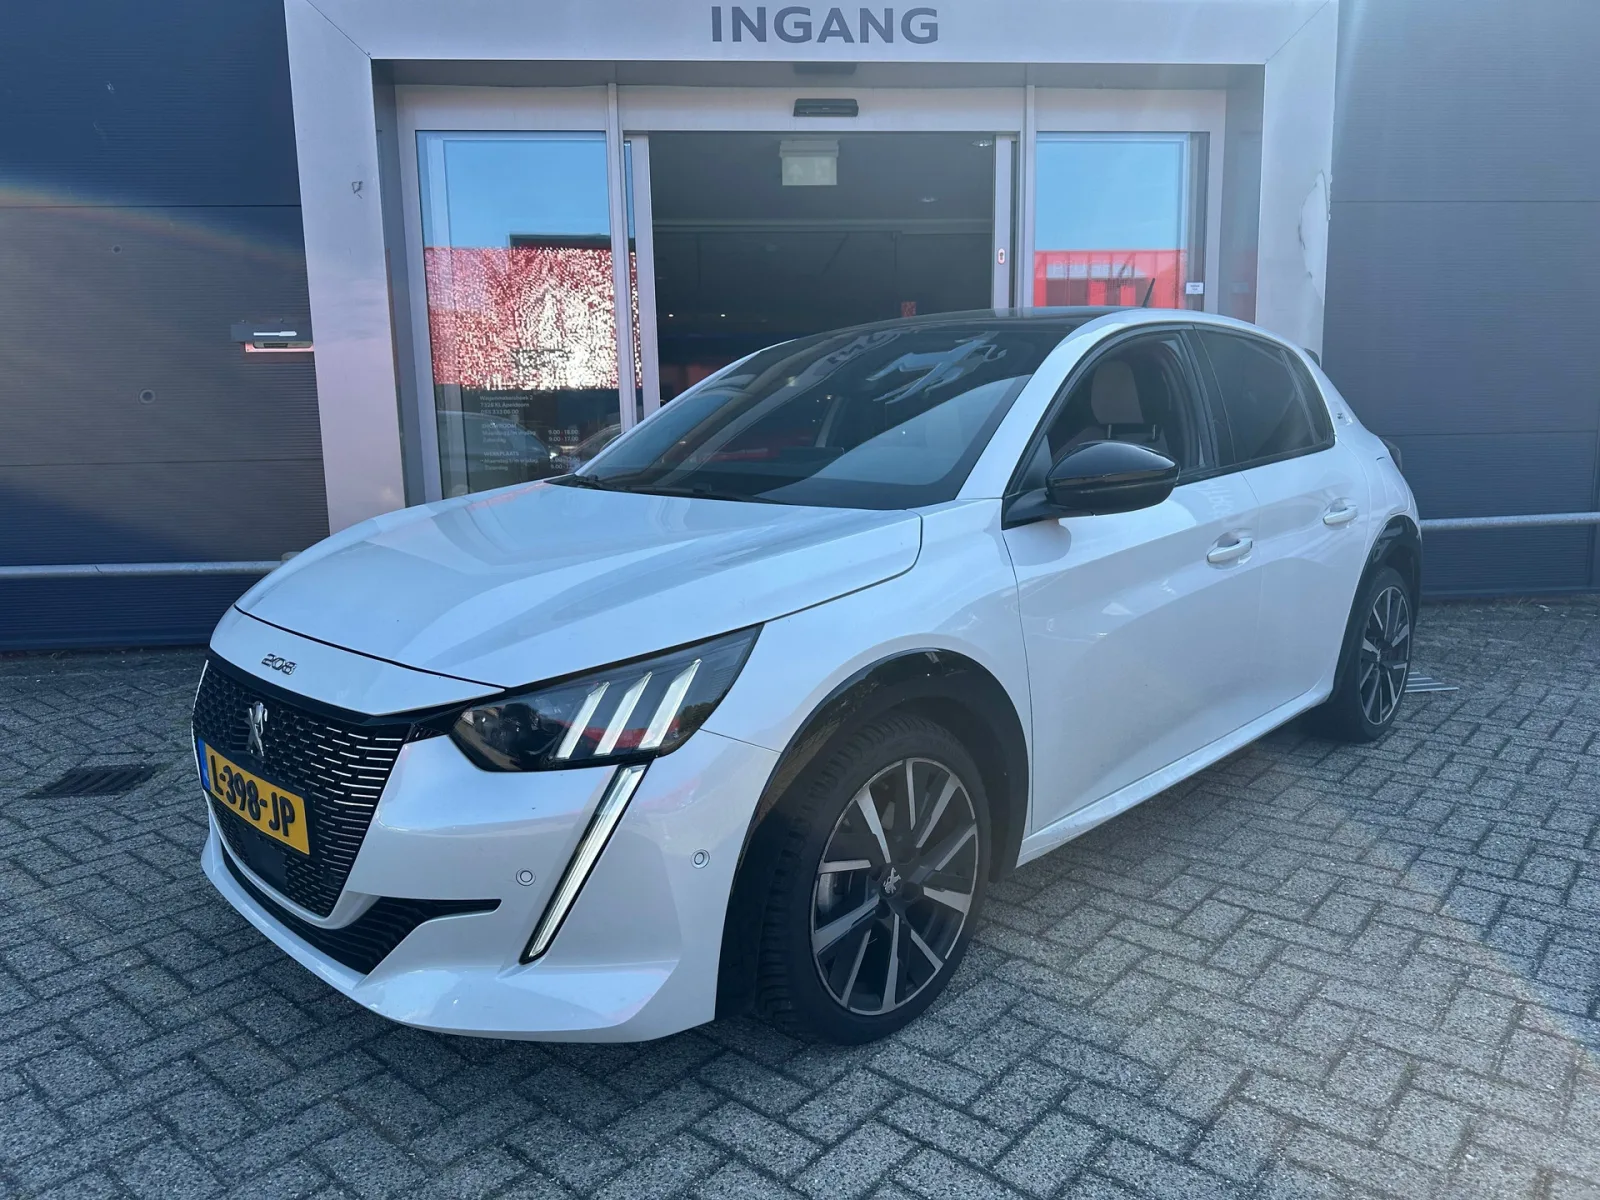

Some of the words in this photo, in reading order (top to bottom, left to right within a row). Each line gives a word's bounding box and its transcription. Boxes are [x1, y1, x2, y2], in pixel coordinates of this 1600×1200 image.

[711, 6, 939, 44] INGANG
[261, 653, 297, 675] 208
[211, 755, 295, 837] L-398-JP
